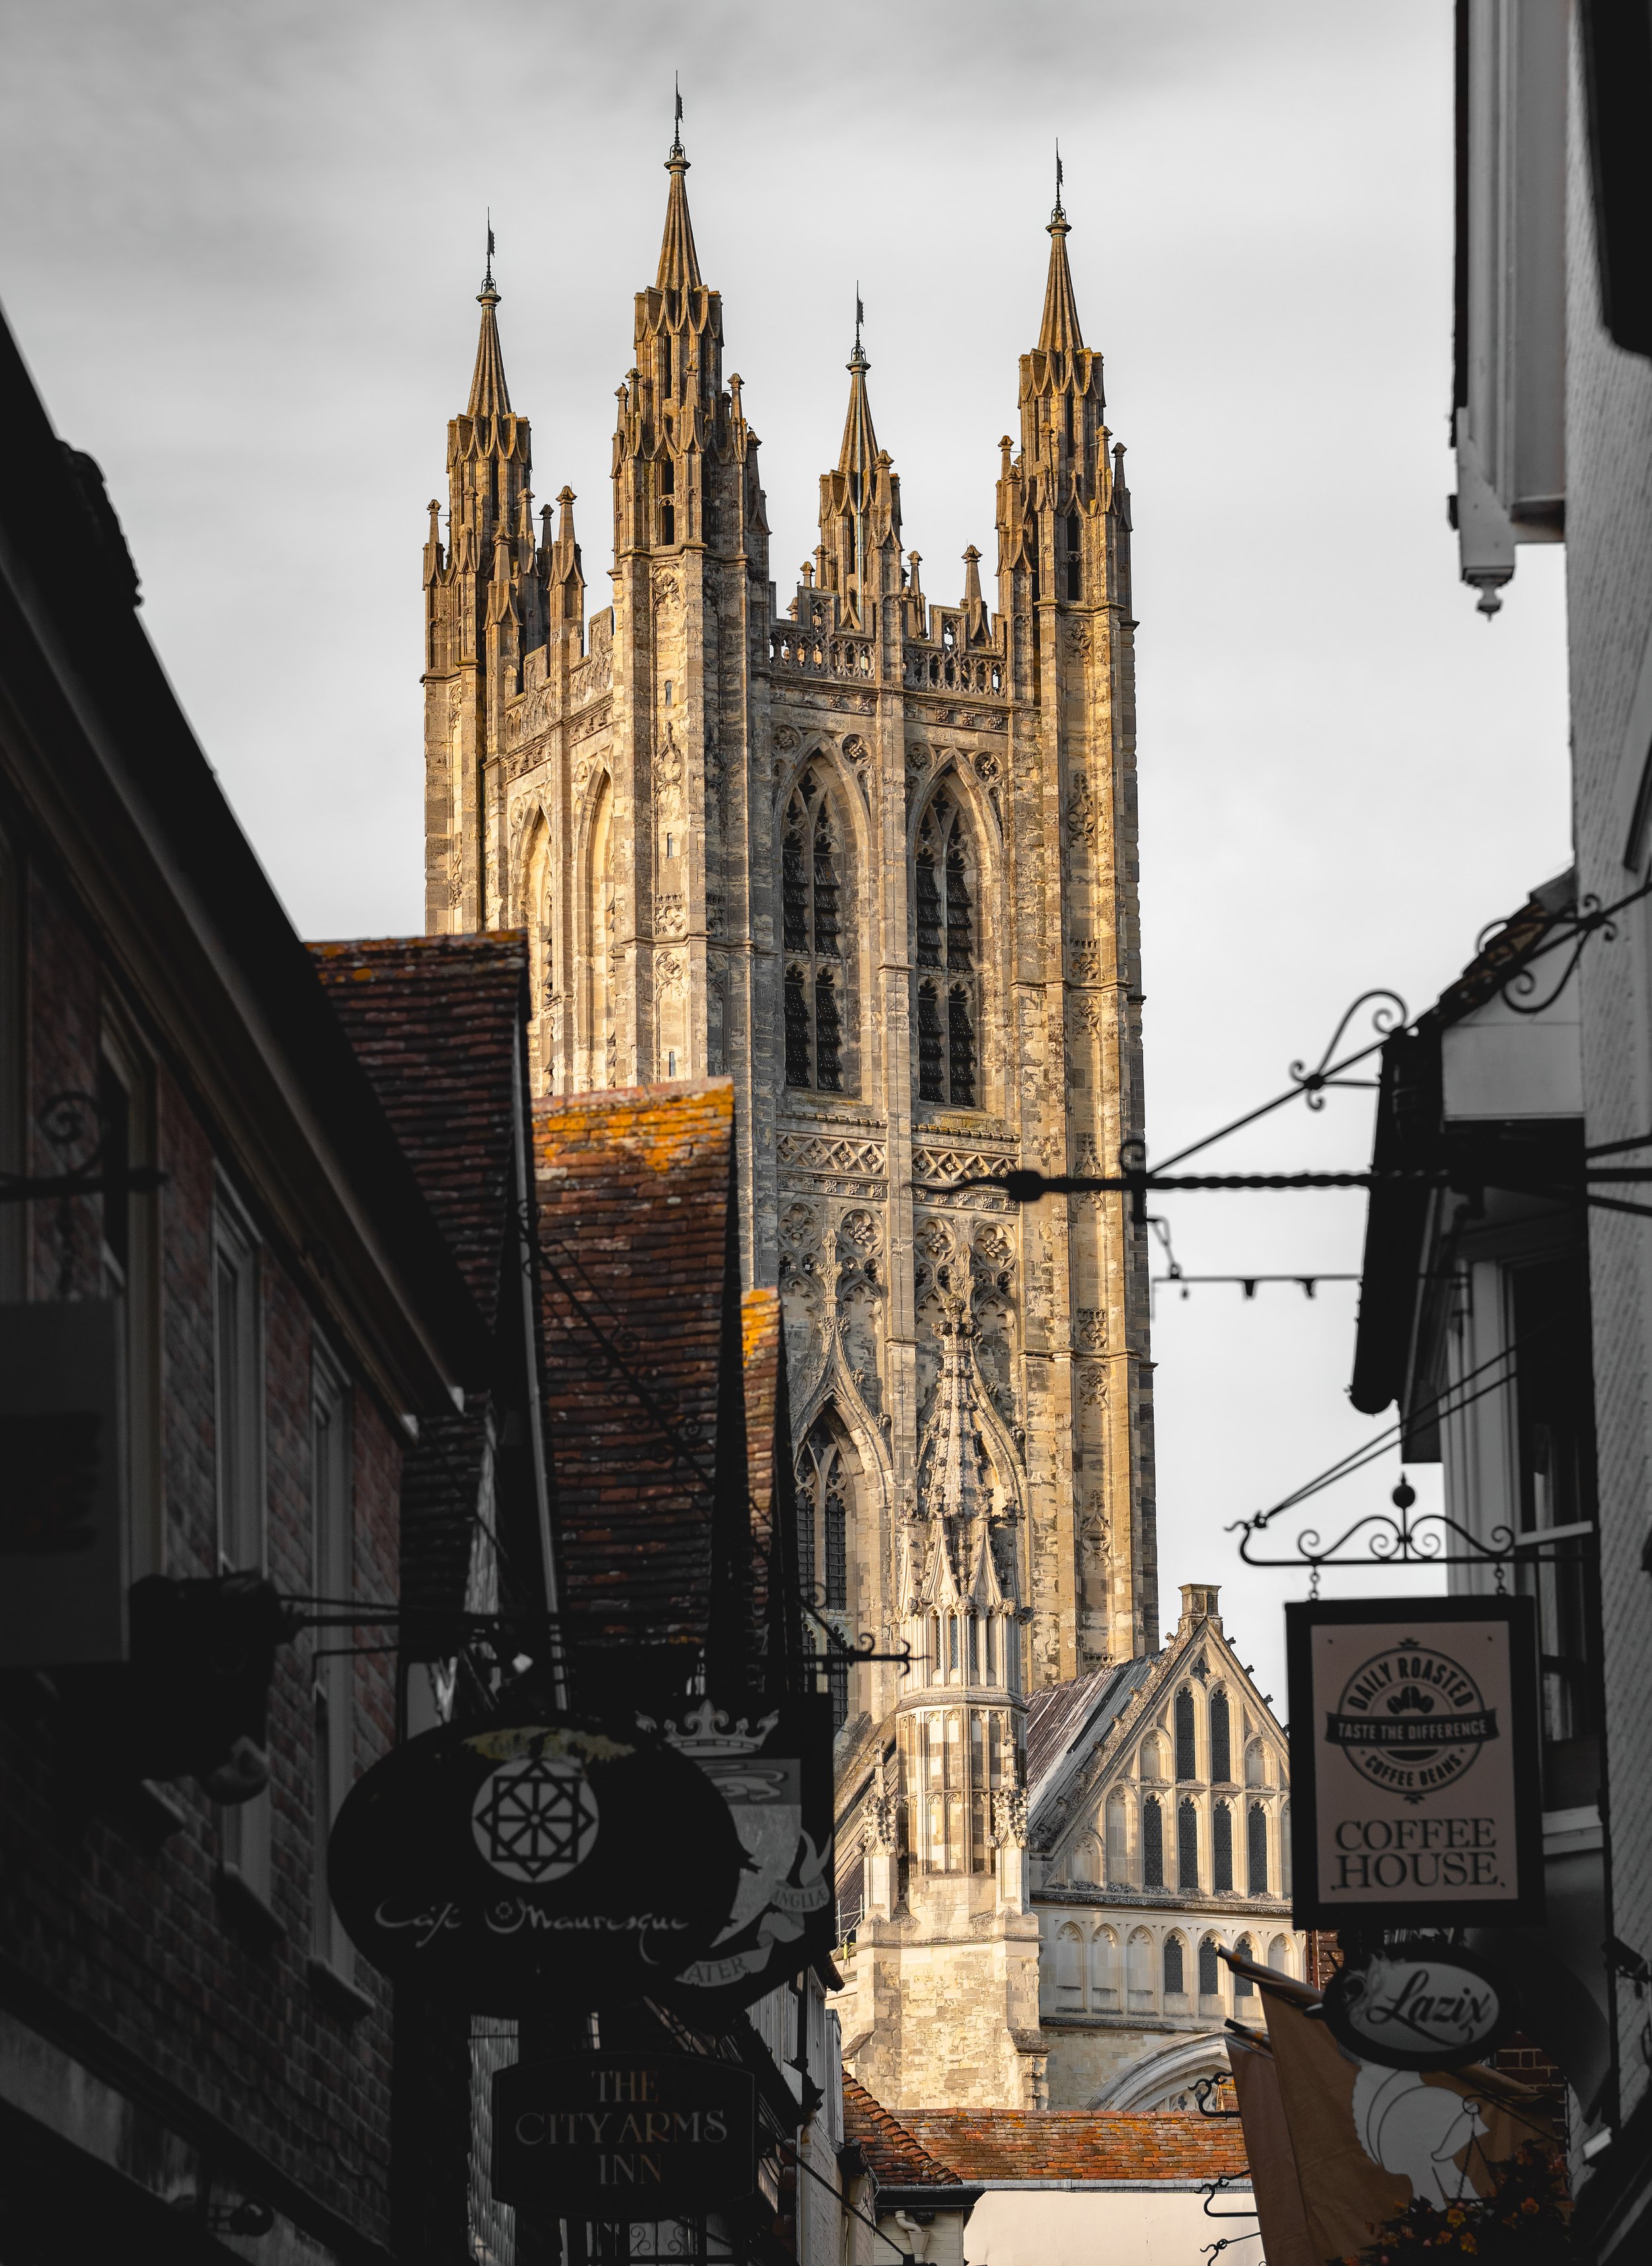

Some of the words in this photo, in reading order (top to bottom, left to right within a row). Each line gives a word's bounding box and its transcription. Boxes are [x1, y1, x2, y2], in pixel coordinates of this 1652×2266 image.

[1347, 1662, 1392, 1710] DAILY
[1398, 1657, 1474, 1708] ROASTED
[1338, 1722, 1376, 1739] TASTE
[1381, 1725, 1404, 1740] THE
[1408, 1719, 1487, 1740] DIFFERENCE
[1365, 1755, 1413, 1787] COFFEE
[1419, 1754, 1462, 1786] BEANS
[1335, 1817, 1497, 1851] COFFEE
[1335, 1852, 1498, 1888] HOUSE
[484, 1896, 689, 1966] Mauresque
[680, 1956, 747, 1982] ATER
[591, 2070, 660, 2103] THE
[515, 2112, 614, 2146] CITY
[617, 2109, 728, 2144] ARMS
[597, 2153, 661, 2185] INN
